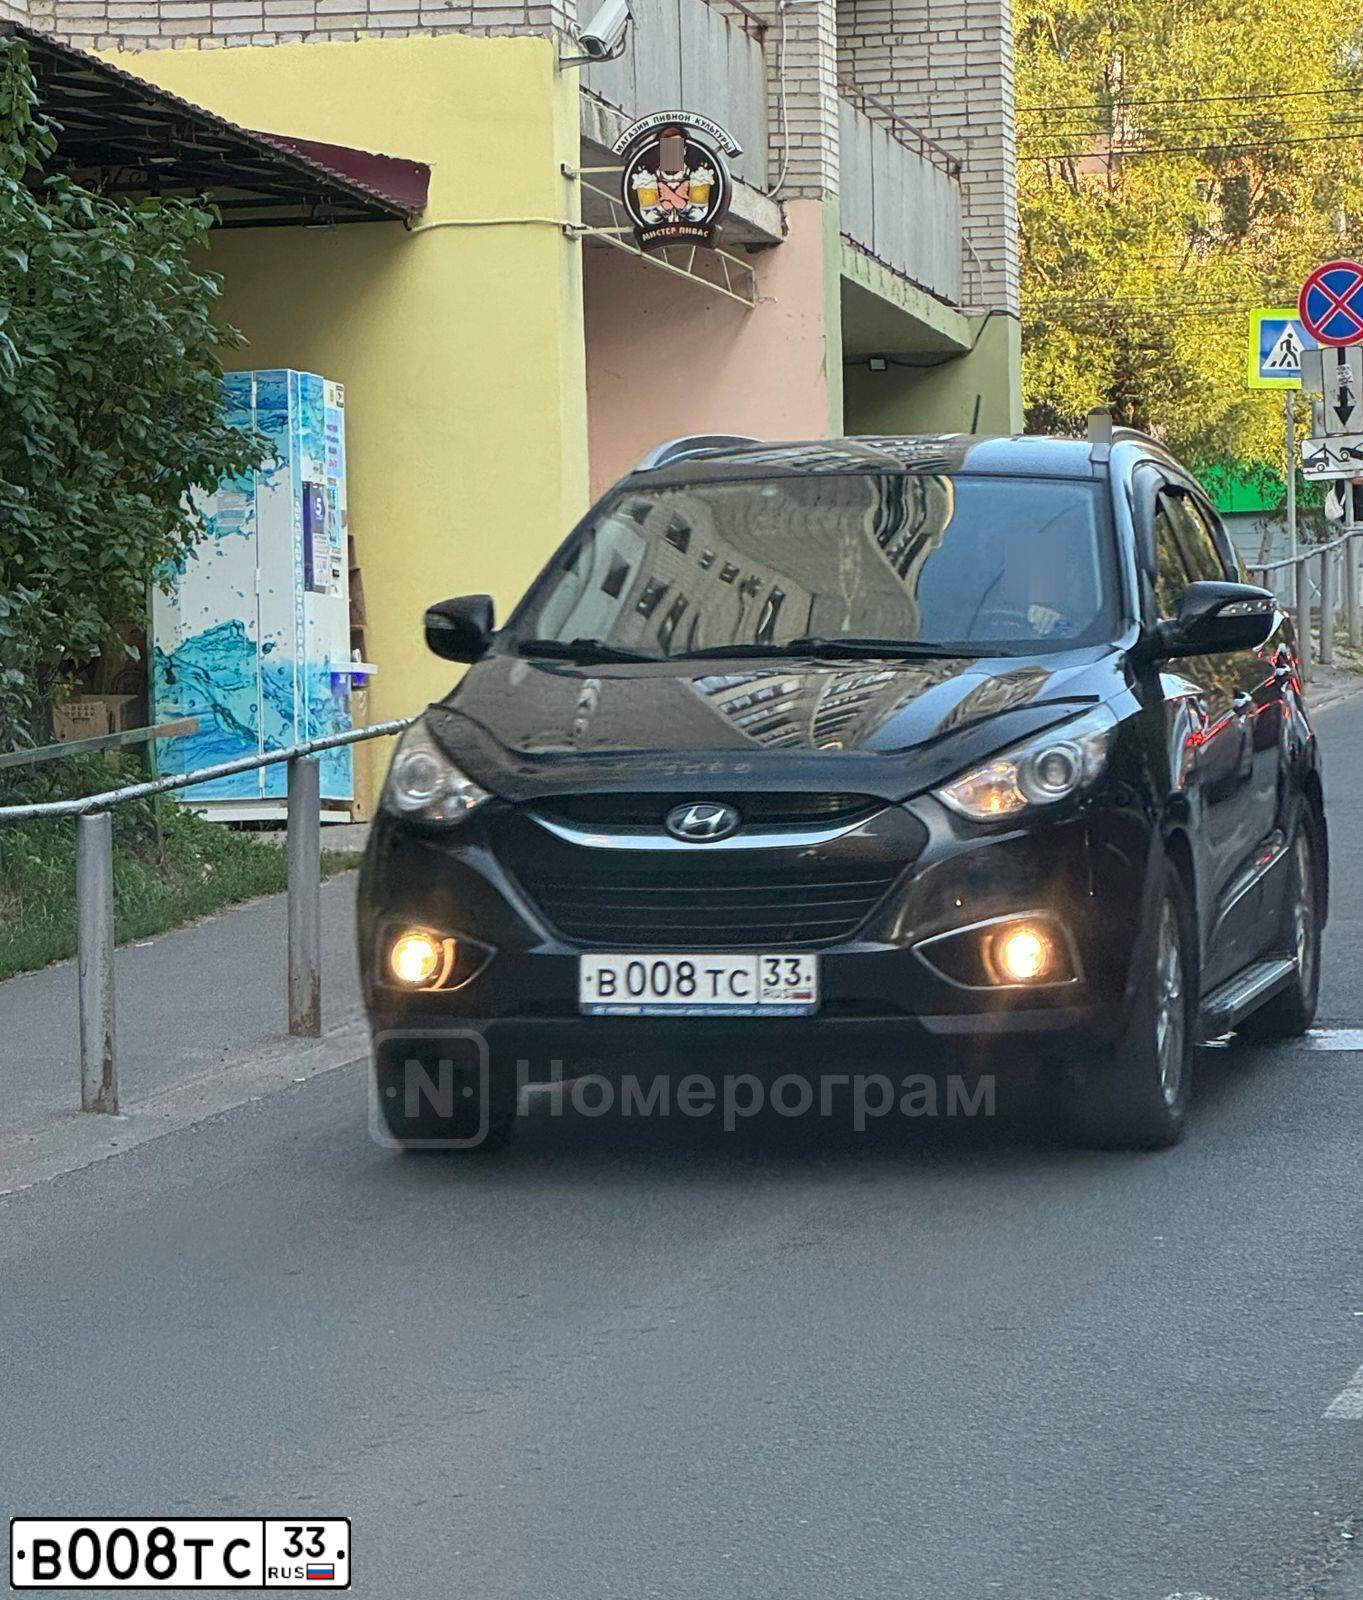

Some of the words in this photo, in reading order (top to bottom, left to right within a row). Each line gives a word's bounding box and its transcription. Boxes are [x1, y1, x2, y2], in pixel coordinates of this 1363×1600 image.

[615, 120, 650, 152] МАГАЗИН
[694, 117, 733, 151] КУЛЬТУРЫ
[642, 227, 676, 241] МИСТЕР
[678, 226, 709, 238] ПИВАС
[764, 958, 801, 986] 33
